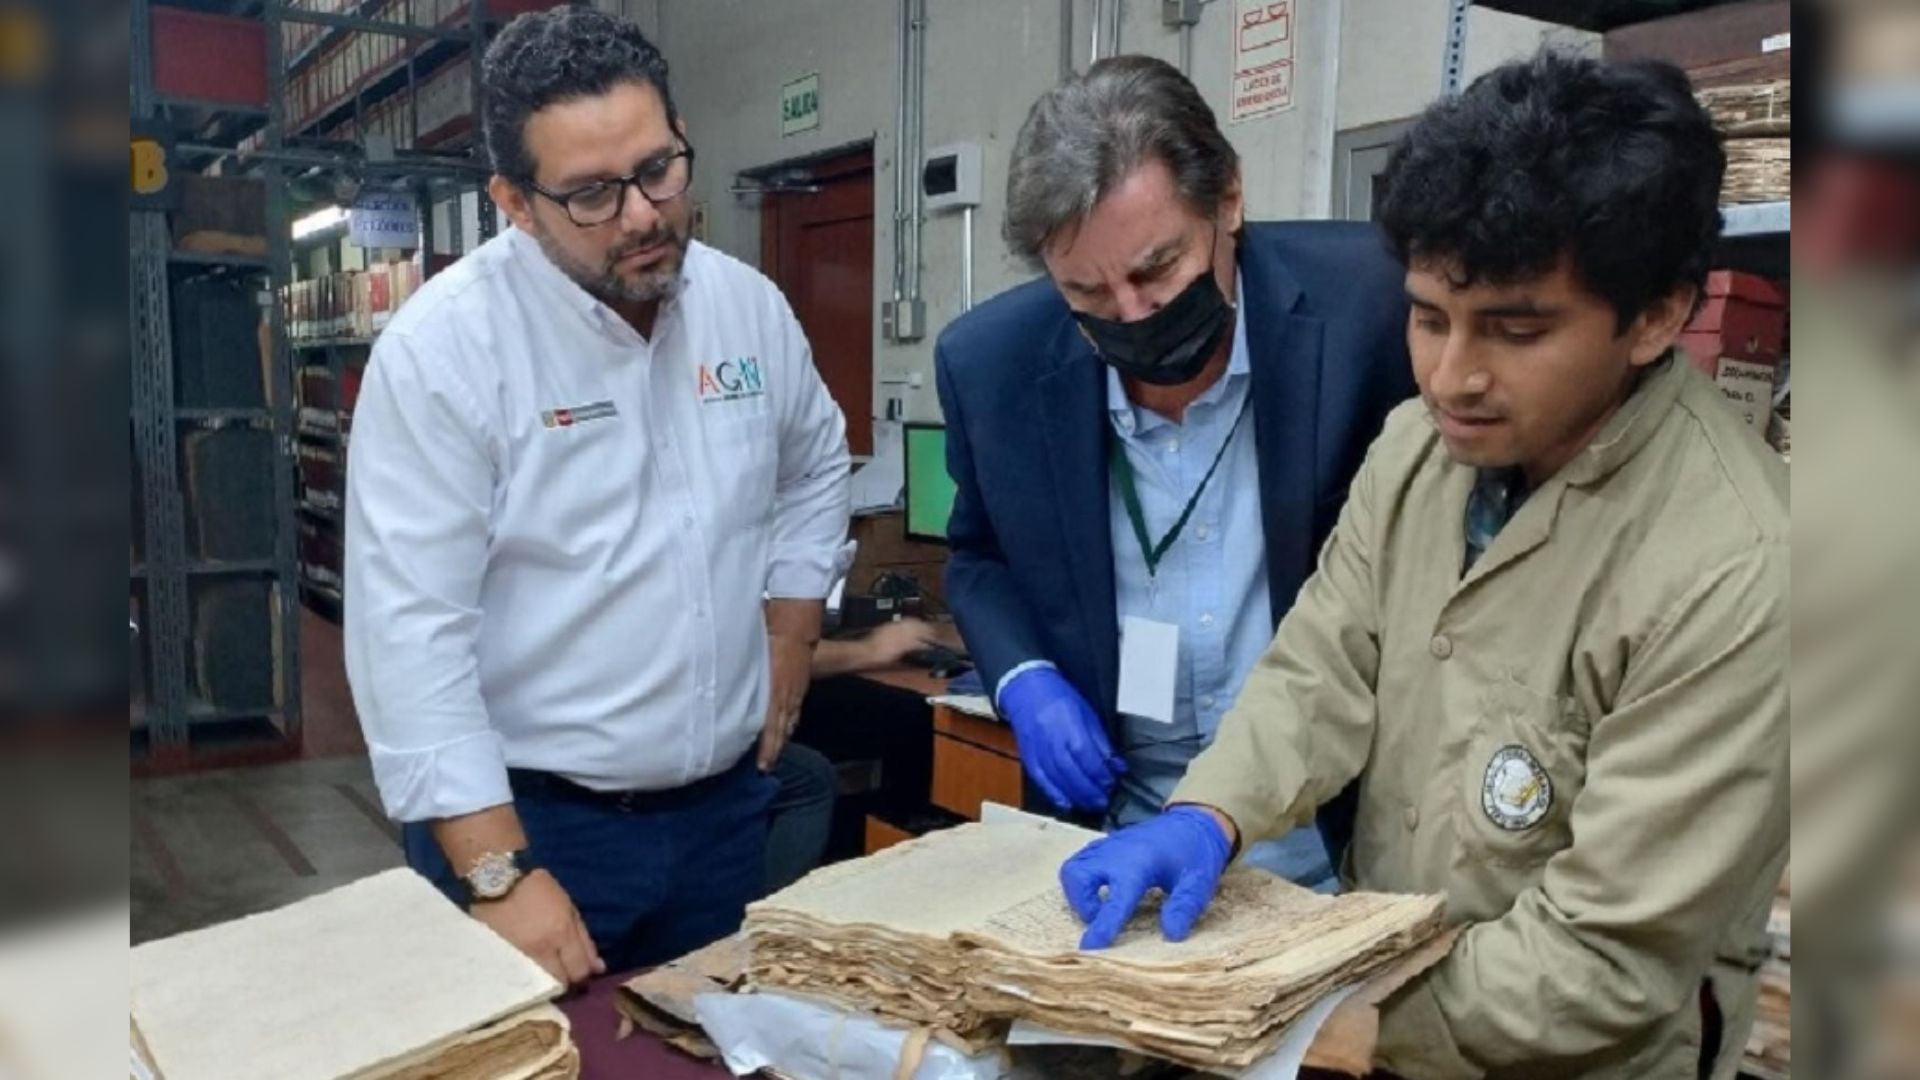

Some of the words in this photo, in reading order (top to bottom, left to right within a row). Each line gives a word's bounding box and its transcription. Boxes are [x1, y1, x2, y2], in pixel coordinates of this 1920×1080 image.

[783, 89, 818, 121] SALIDA
[130, 137, 168, 194] B
[698, 356, 762, 396] AGN
